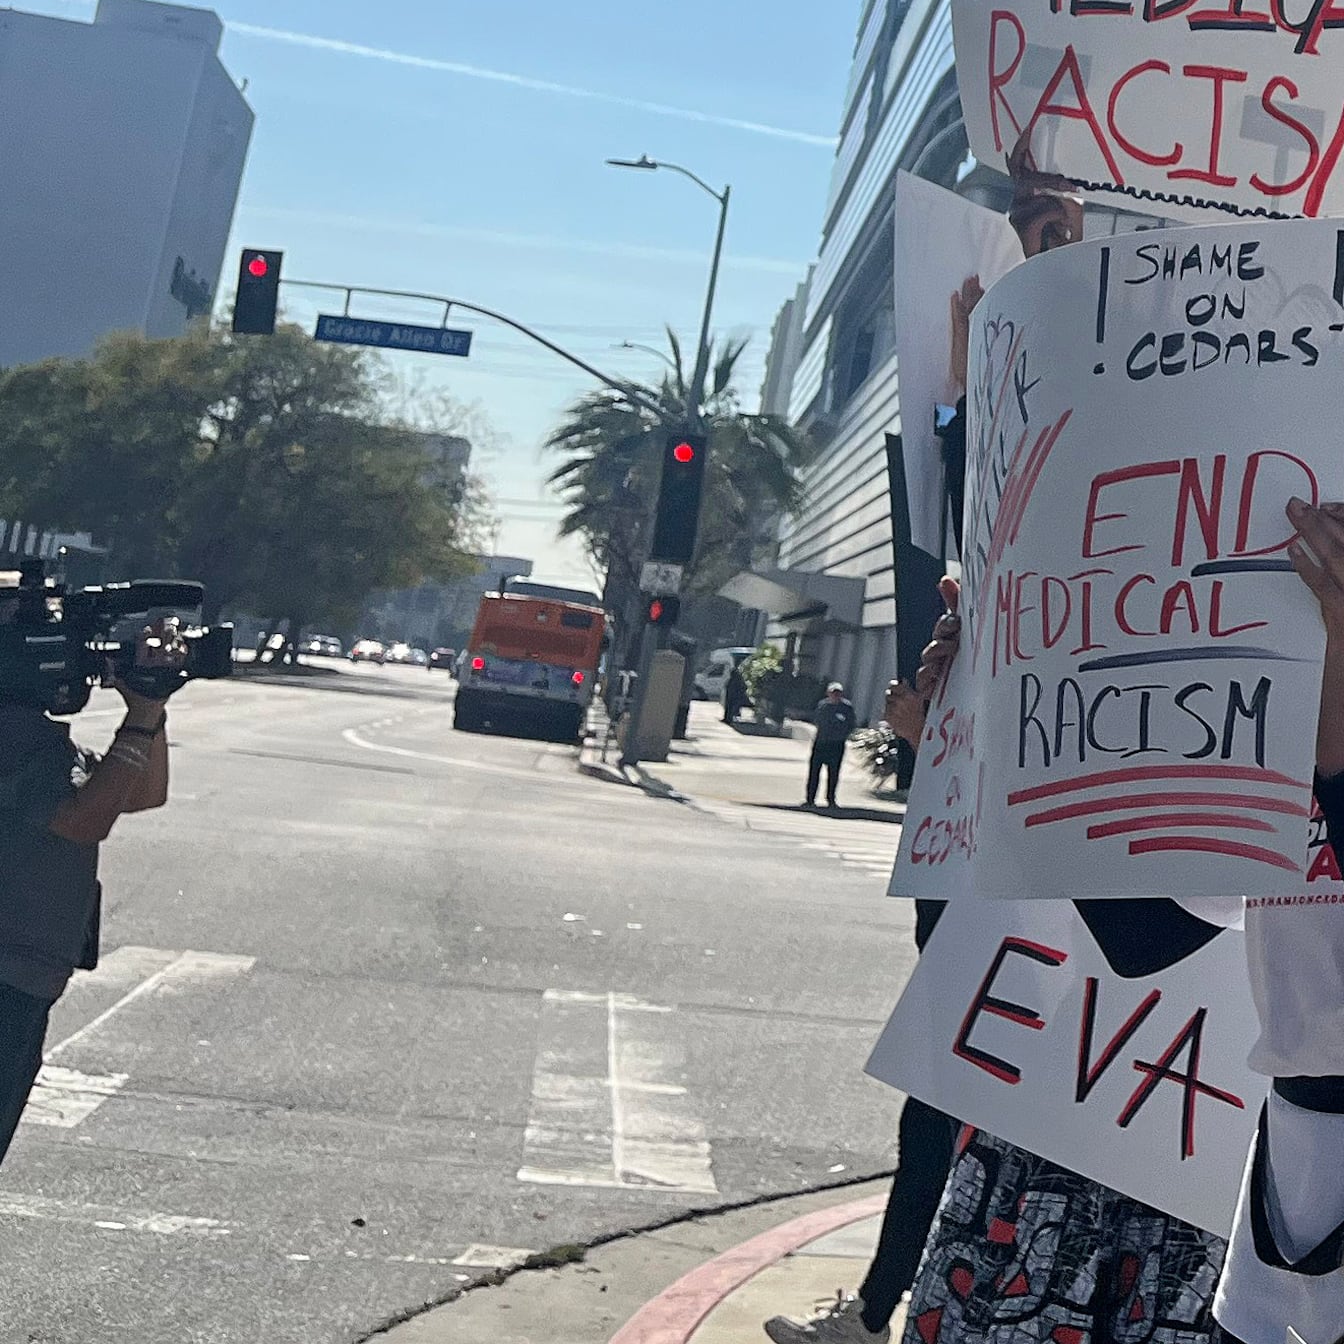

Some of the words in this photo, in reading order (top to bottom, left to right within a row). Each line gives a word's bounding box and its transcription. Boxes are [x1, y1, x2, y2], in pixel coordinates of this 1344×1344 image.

[1123, 240, 1266, 287] SHAME
[1184, 288, 1247, 327] ON
[1125, 327, 1321, 380] CEDARS
[1081, 450, 1319, 568] END
[990, 568, 1270, 679] MEDICAL
[1018, 672, 1272, 769] RACISM
[952, 935, 1246, 1162] EVA
